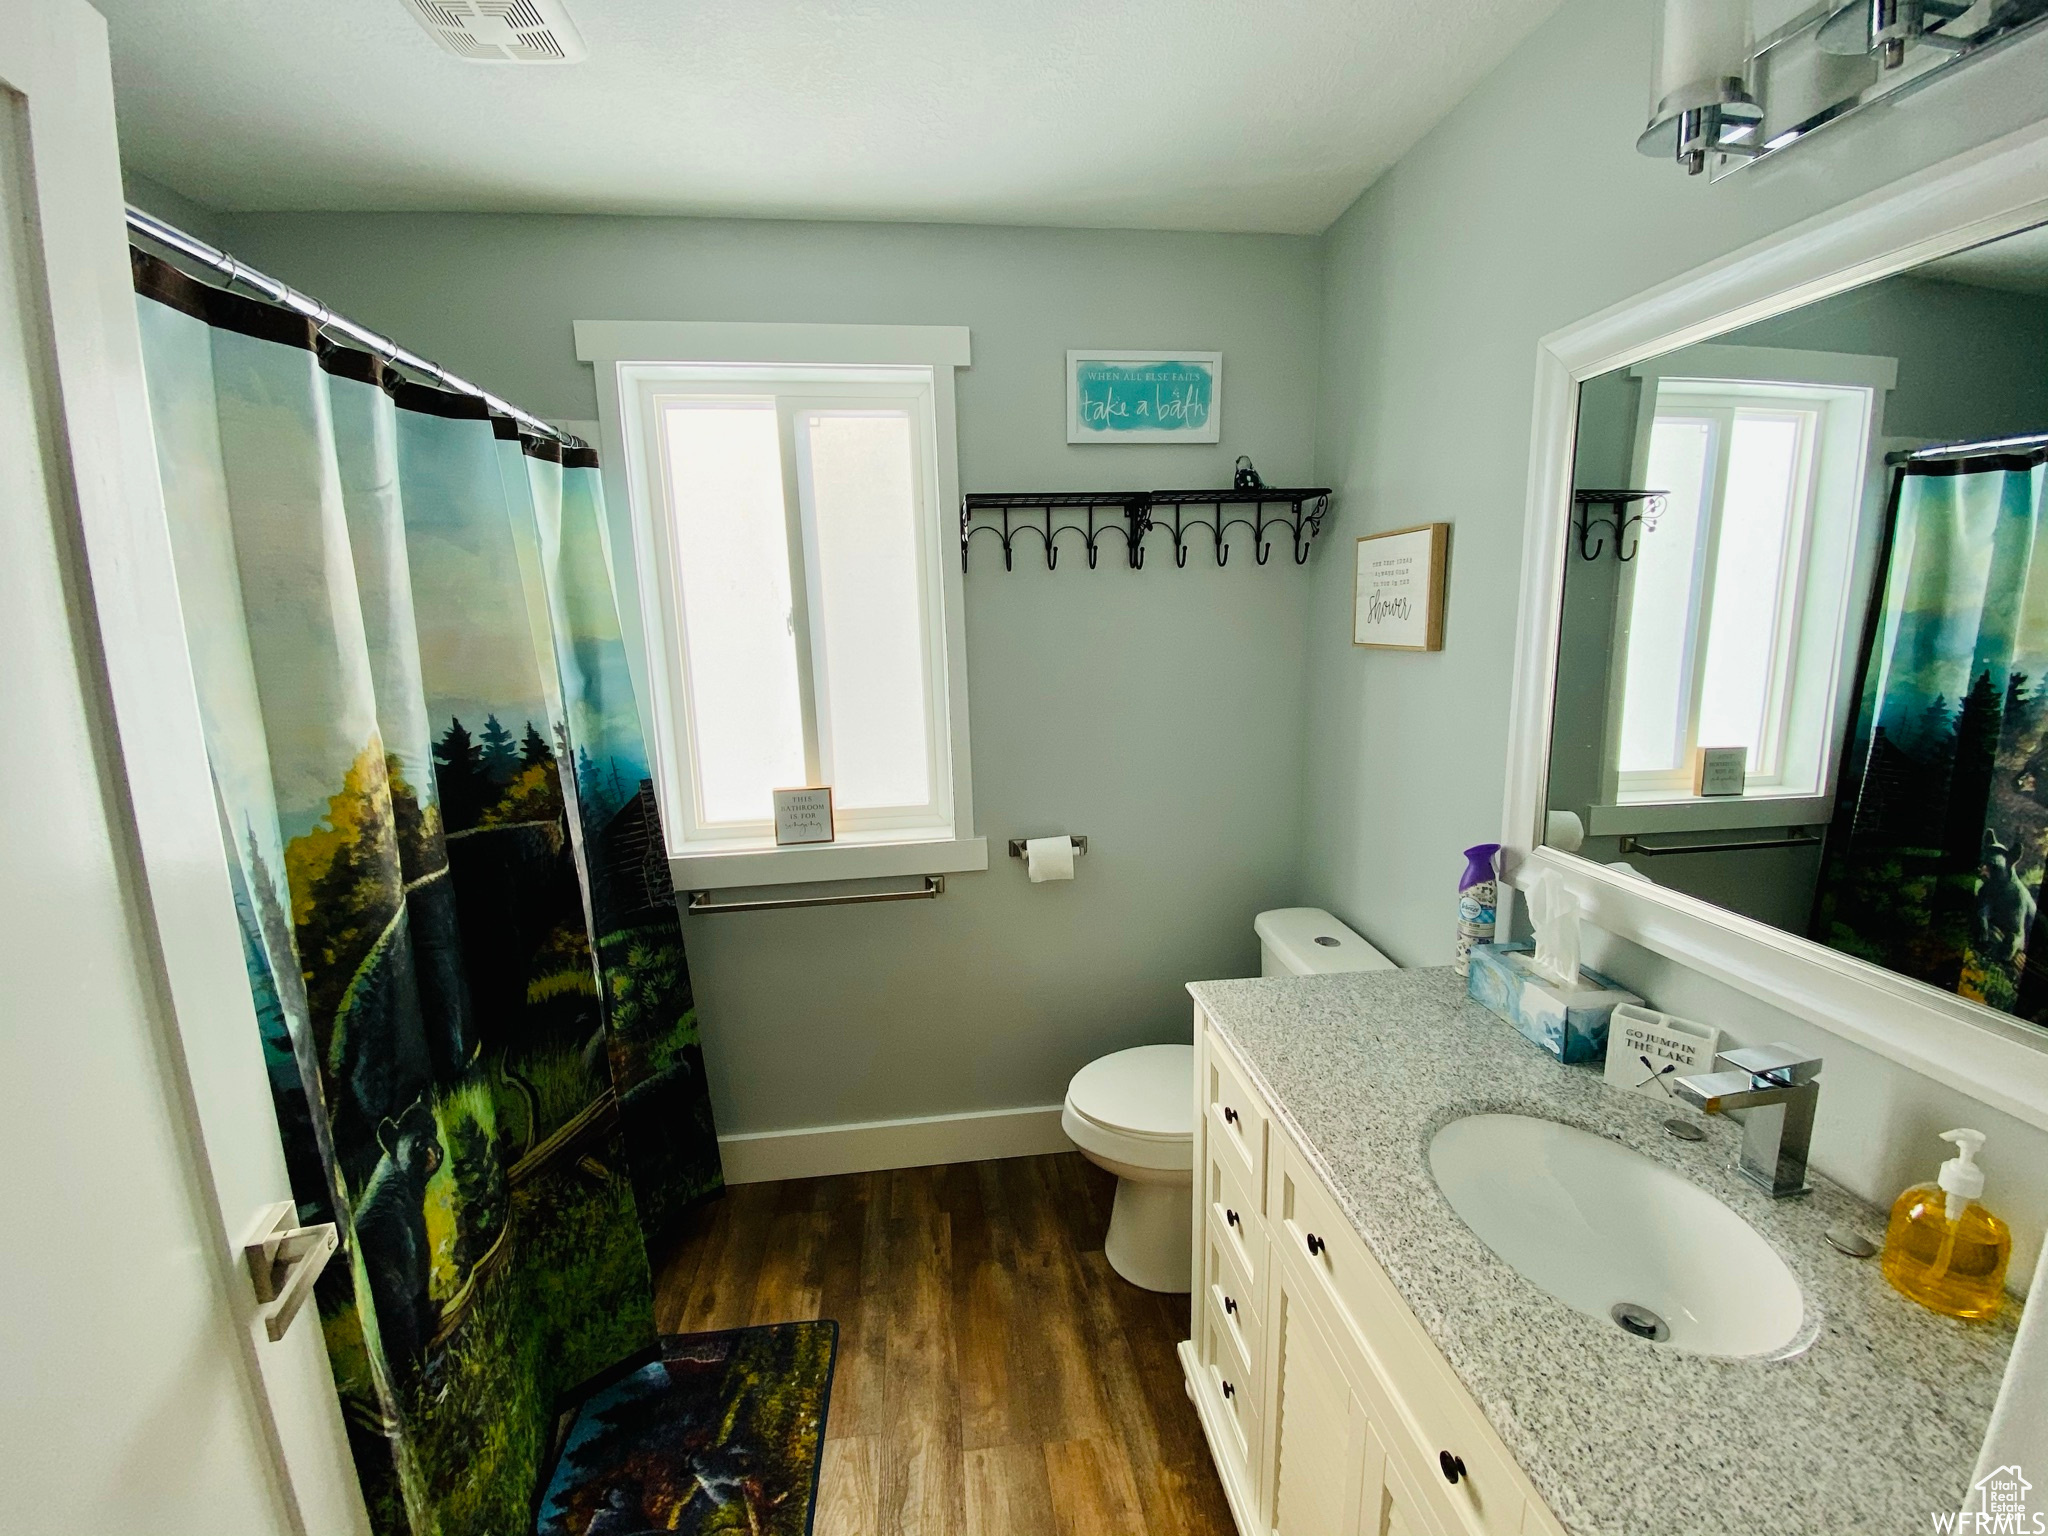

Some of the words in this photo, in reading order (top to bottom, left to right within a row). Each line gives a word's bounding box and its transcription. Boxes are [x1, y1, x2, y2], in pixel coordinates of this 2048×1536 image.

[1088, 372, 1120, 381] WHEN
[1123, 372, 1142, 381] ALL
[1145, 372, 1169, 381] ELSE
[1172, 373, 1200, 381] FAILS
[1082, 387, 1129, 426] take
[1136, 400, 1149, 416] a
[1156, 384, 1205, 428] bath
[780, 804, 825, 812] BATHROOM
[1625, 1028, 1644, 1039] GO
[1646, 1033, 1679, 1049] JUMP
[1681, 1044, 1696, 1055] IN
[1625, 1038, 1654, 1054] THE
[1657, 1047, 1695, 1066] LAKE
